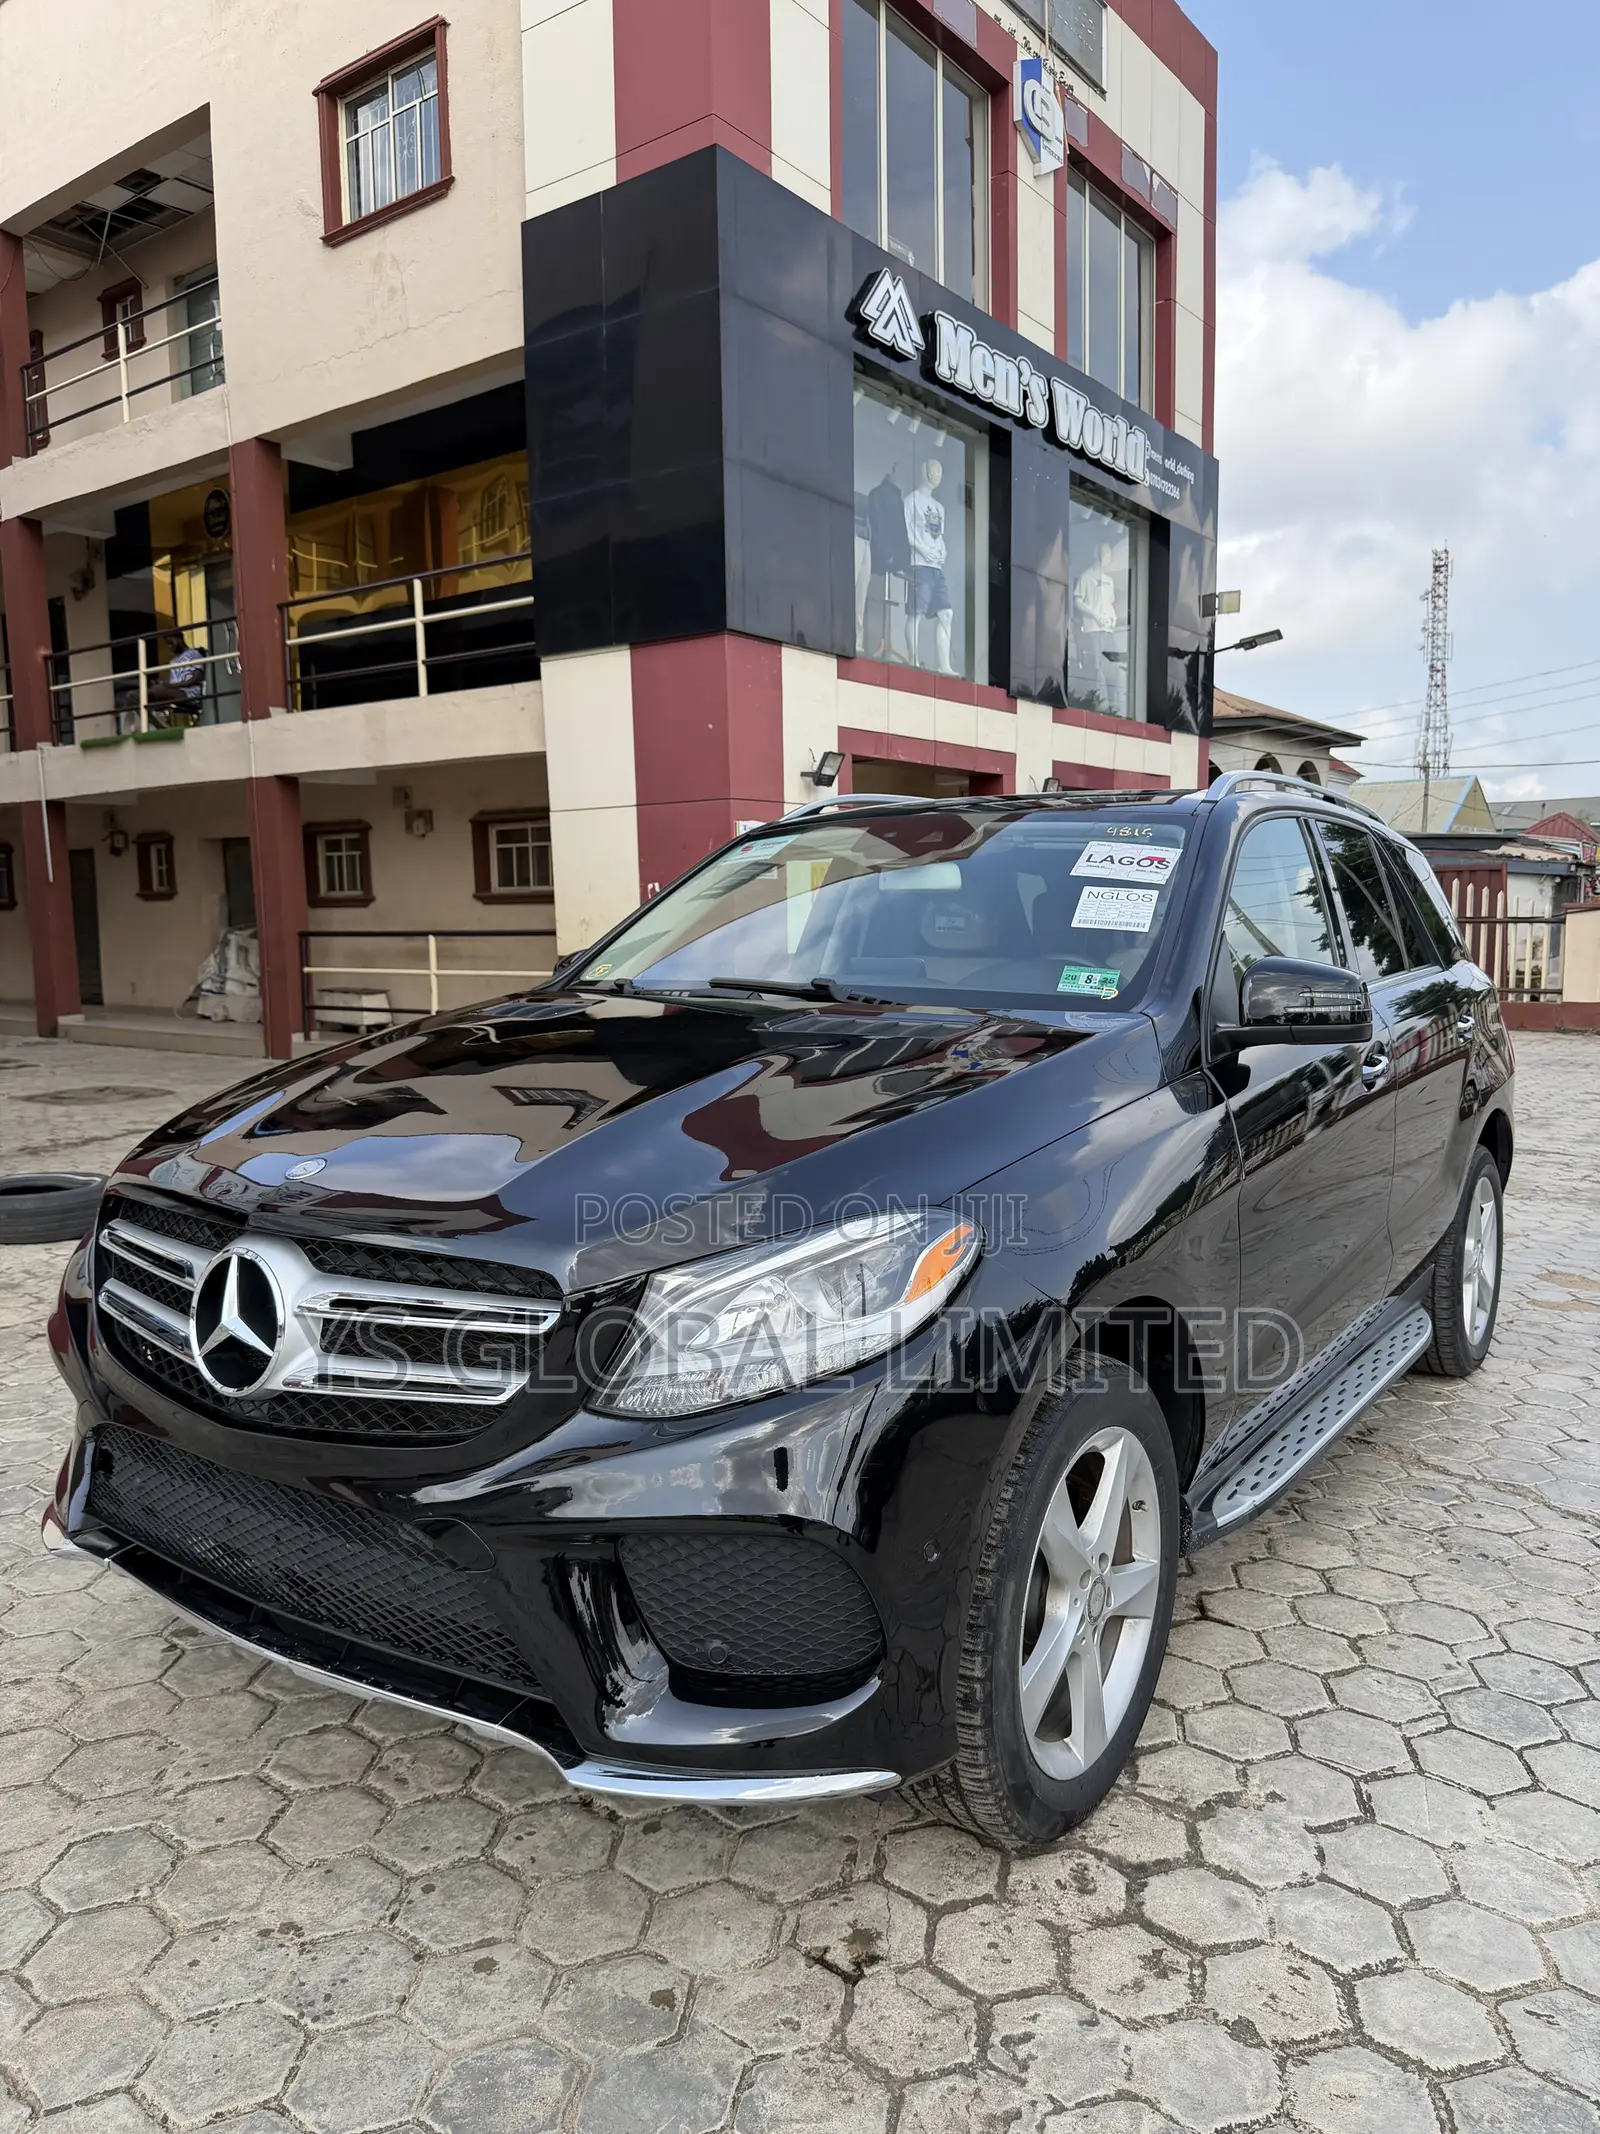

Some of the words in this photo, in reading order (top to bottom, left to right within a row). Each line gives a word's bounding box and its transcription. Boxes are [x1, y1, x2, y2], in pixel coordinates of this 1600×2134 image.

[934, 309, 1049, 429] Men's
[1050, 376, 1150, 484] World
[1085, 853, 1171, 870] LAGOS
[1086, 891, 1154, 903] NGLOS
[1064, 973, 1077, 981] 20
[1084, 974, 1094, 985] 8
